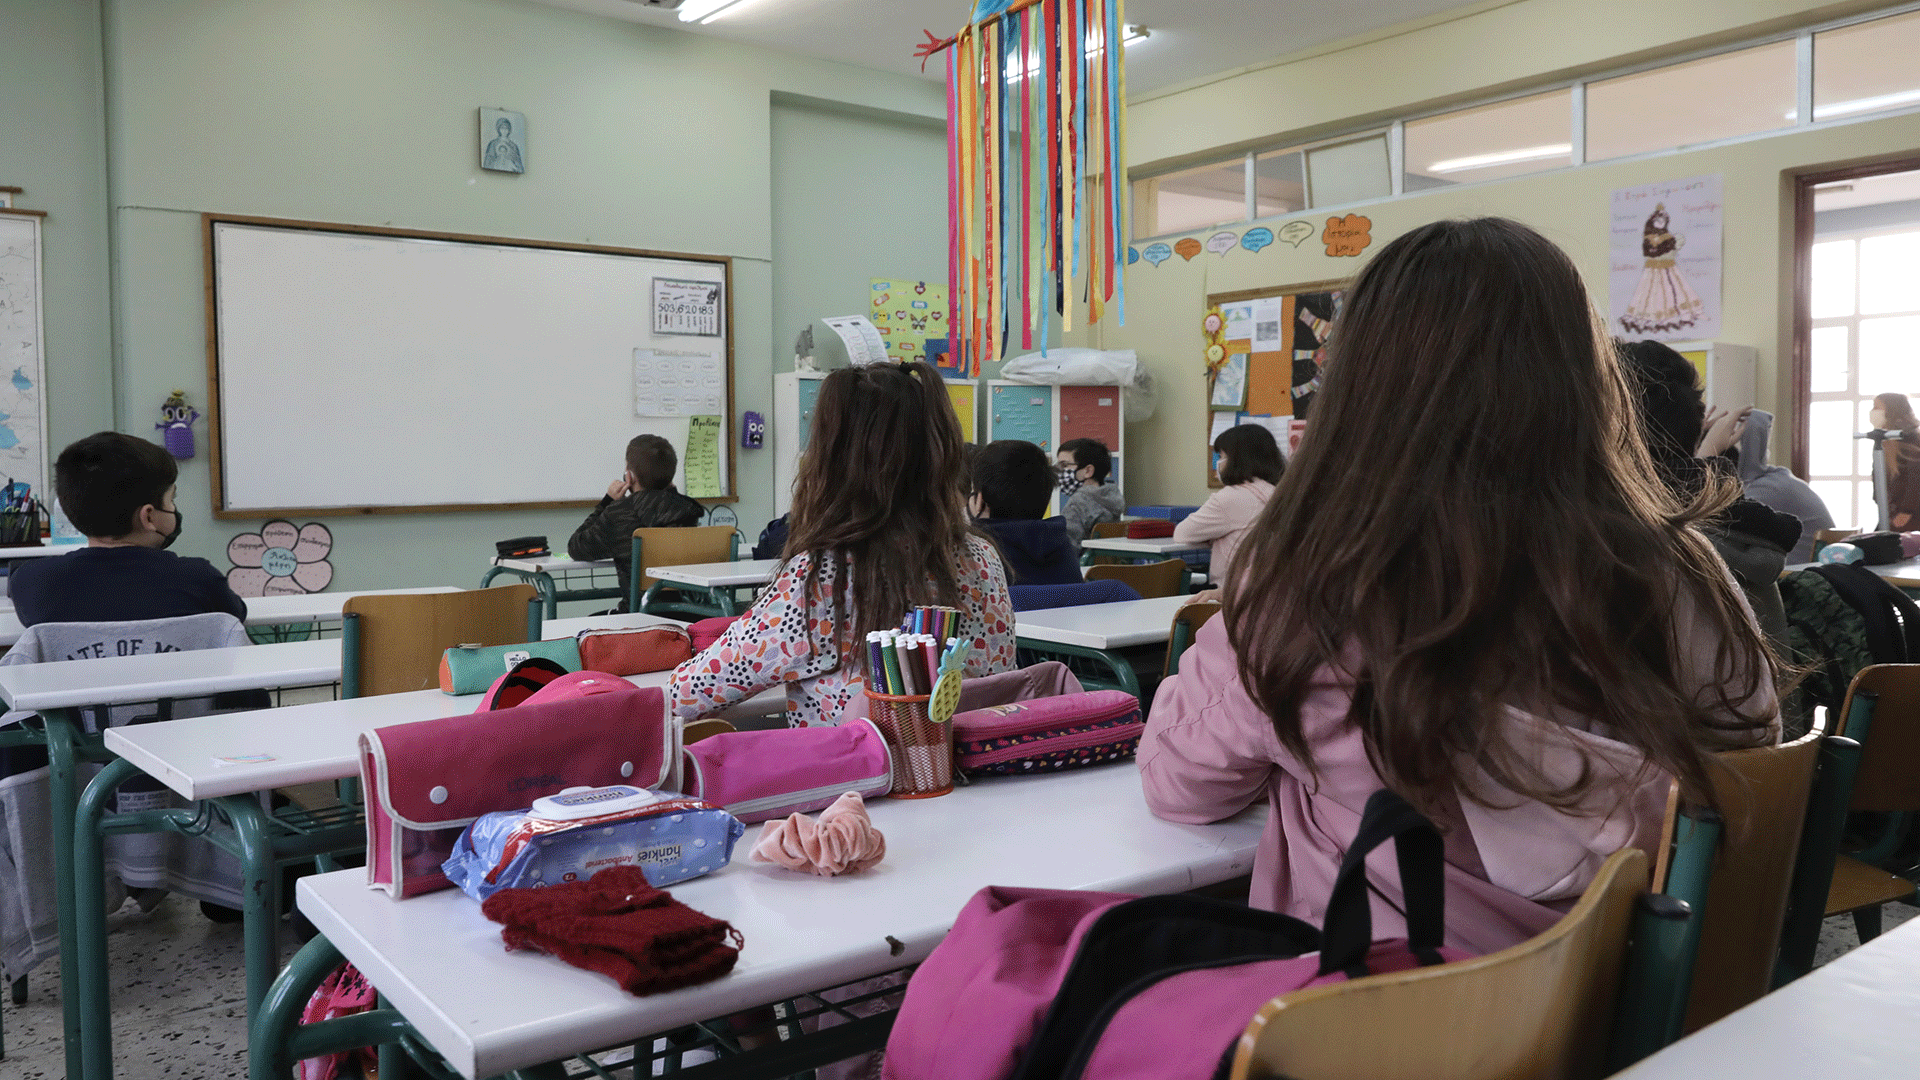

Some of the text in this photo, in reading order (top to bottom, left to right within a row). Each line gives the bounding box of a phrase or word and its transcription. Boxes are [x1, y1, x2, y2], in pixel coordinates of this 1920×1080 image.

[116, 639, 144, 657] OF
[585, 854, 634, 870] Antibacterial
[637, 845, 682, 863] hankies
